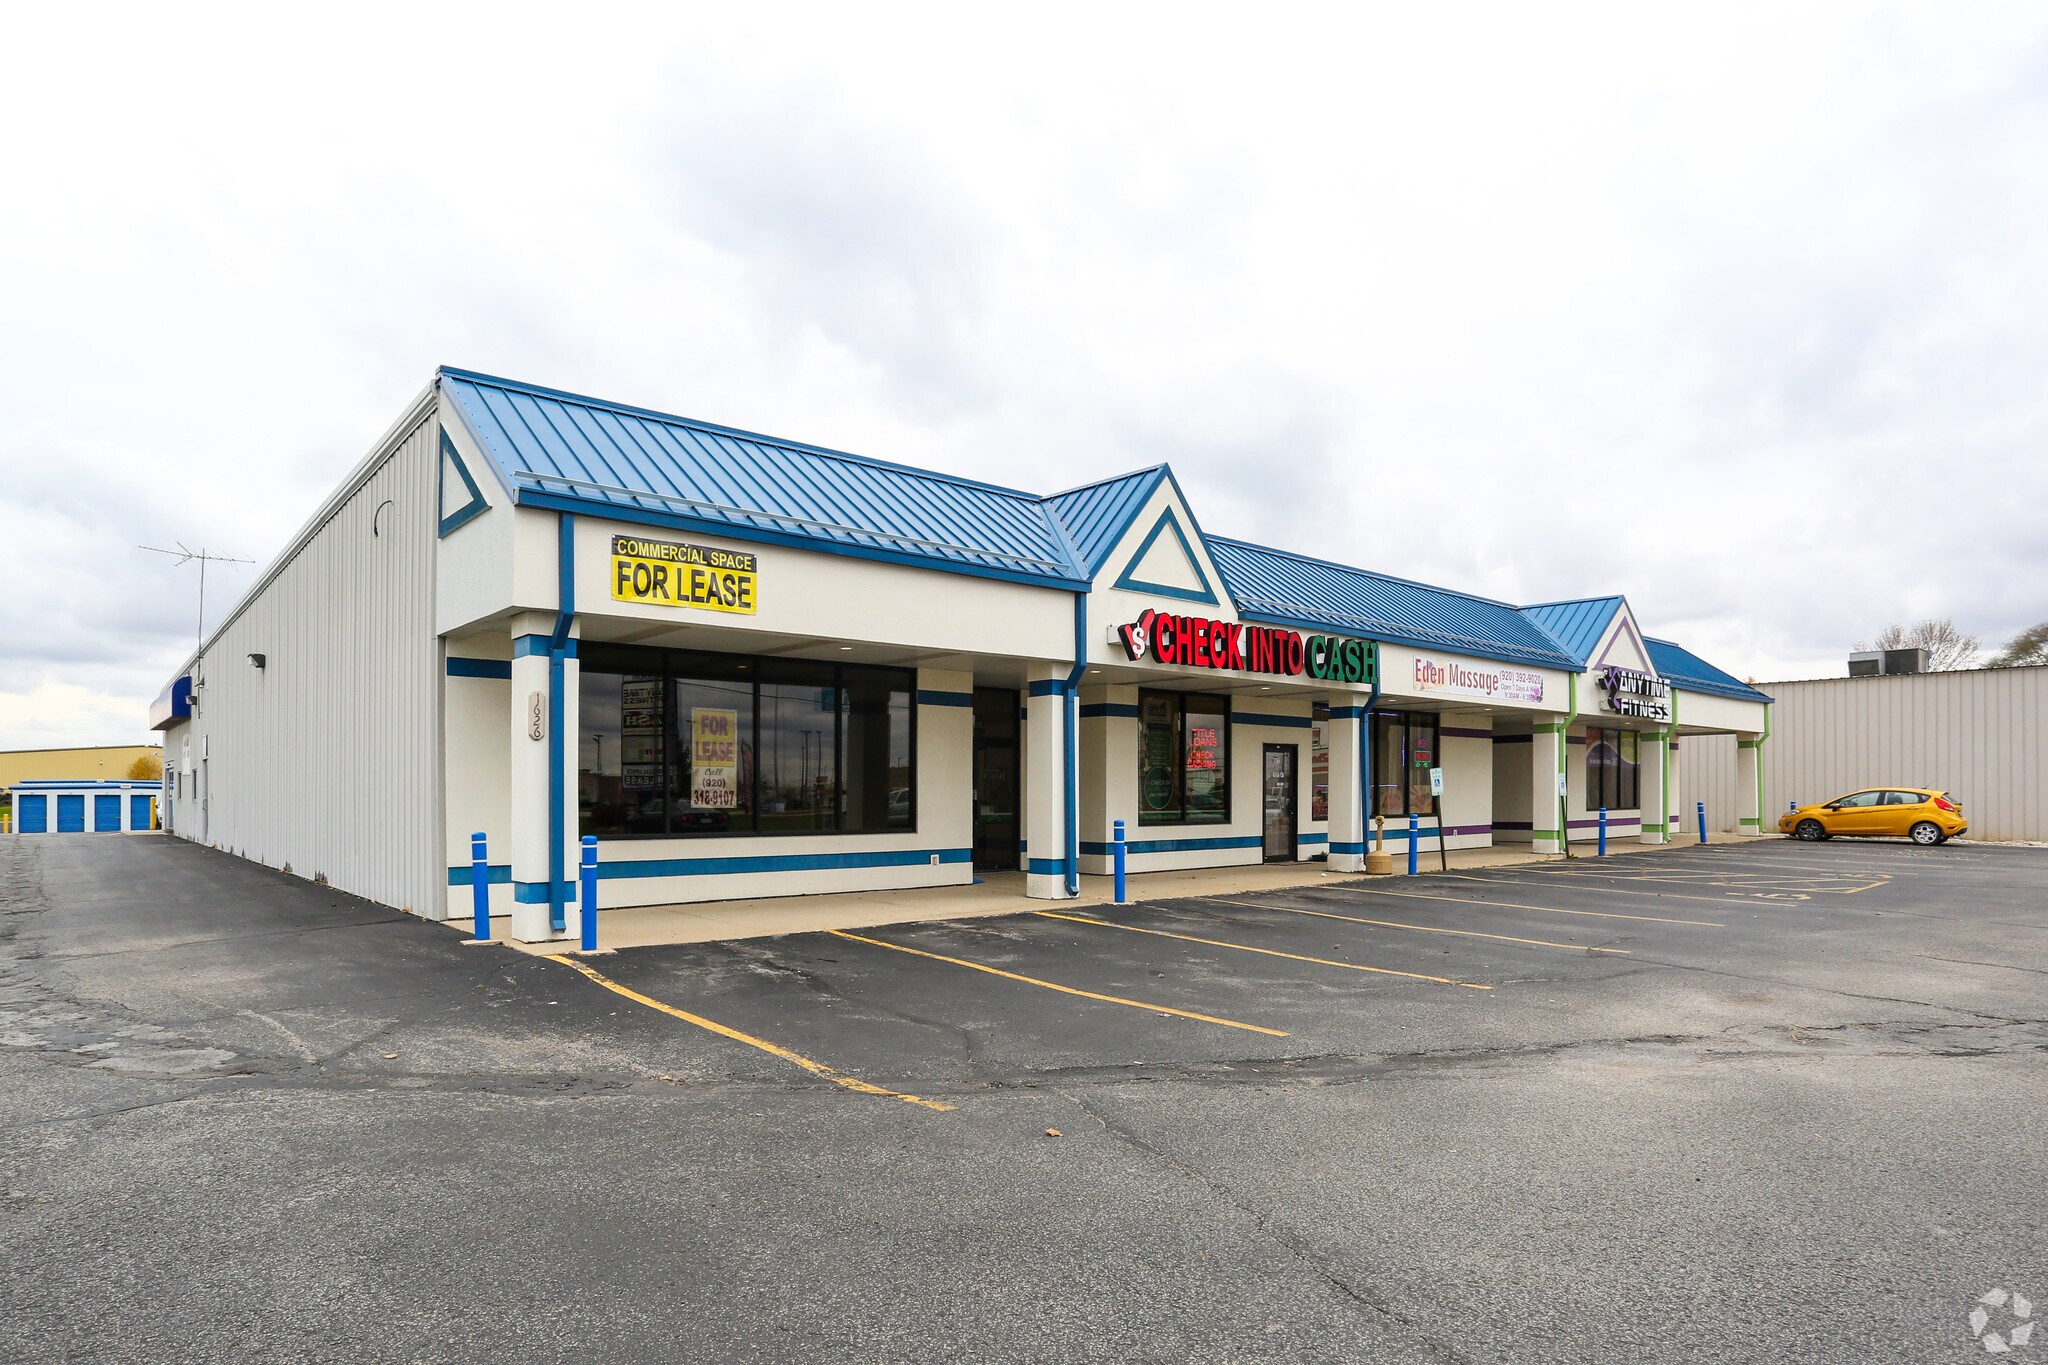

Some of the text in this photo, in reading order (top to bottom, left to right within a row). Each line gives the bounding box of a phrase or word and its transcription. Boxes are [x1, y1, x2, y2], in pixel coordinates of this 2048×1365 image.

[617, 539, 752, 570] COMMERCIAL SPACE
[617, 560, 752, 608] FOR LEASE
[1152, 612, 1244, 671] CHECK
[1247, 626, 1304, 676] INTO
[1305, 635, 1379, 684] CASH
[1415, 658, 1499, 695] Eden Massage
[1500, 669, 1515, 683] (920)
[1620, 670, 1671, 699] ANYTIME
[533, 692, 541, 738] 1626
[1621, 697, 1671, 720] FITNESS
[701, 715, 728, 736] FOR
[695, 741, 734, 762] LEASE
[1190, 750, 1214, 760] CHECK
[703, 778, 726, 788] (920)
[704, 768, 723, 776] Call
[693, 789, 735, 805] 318-9107
